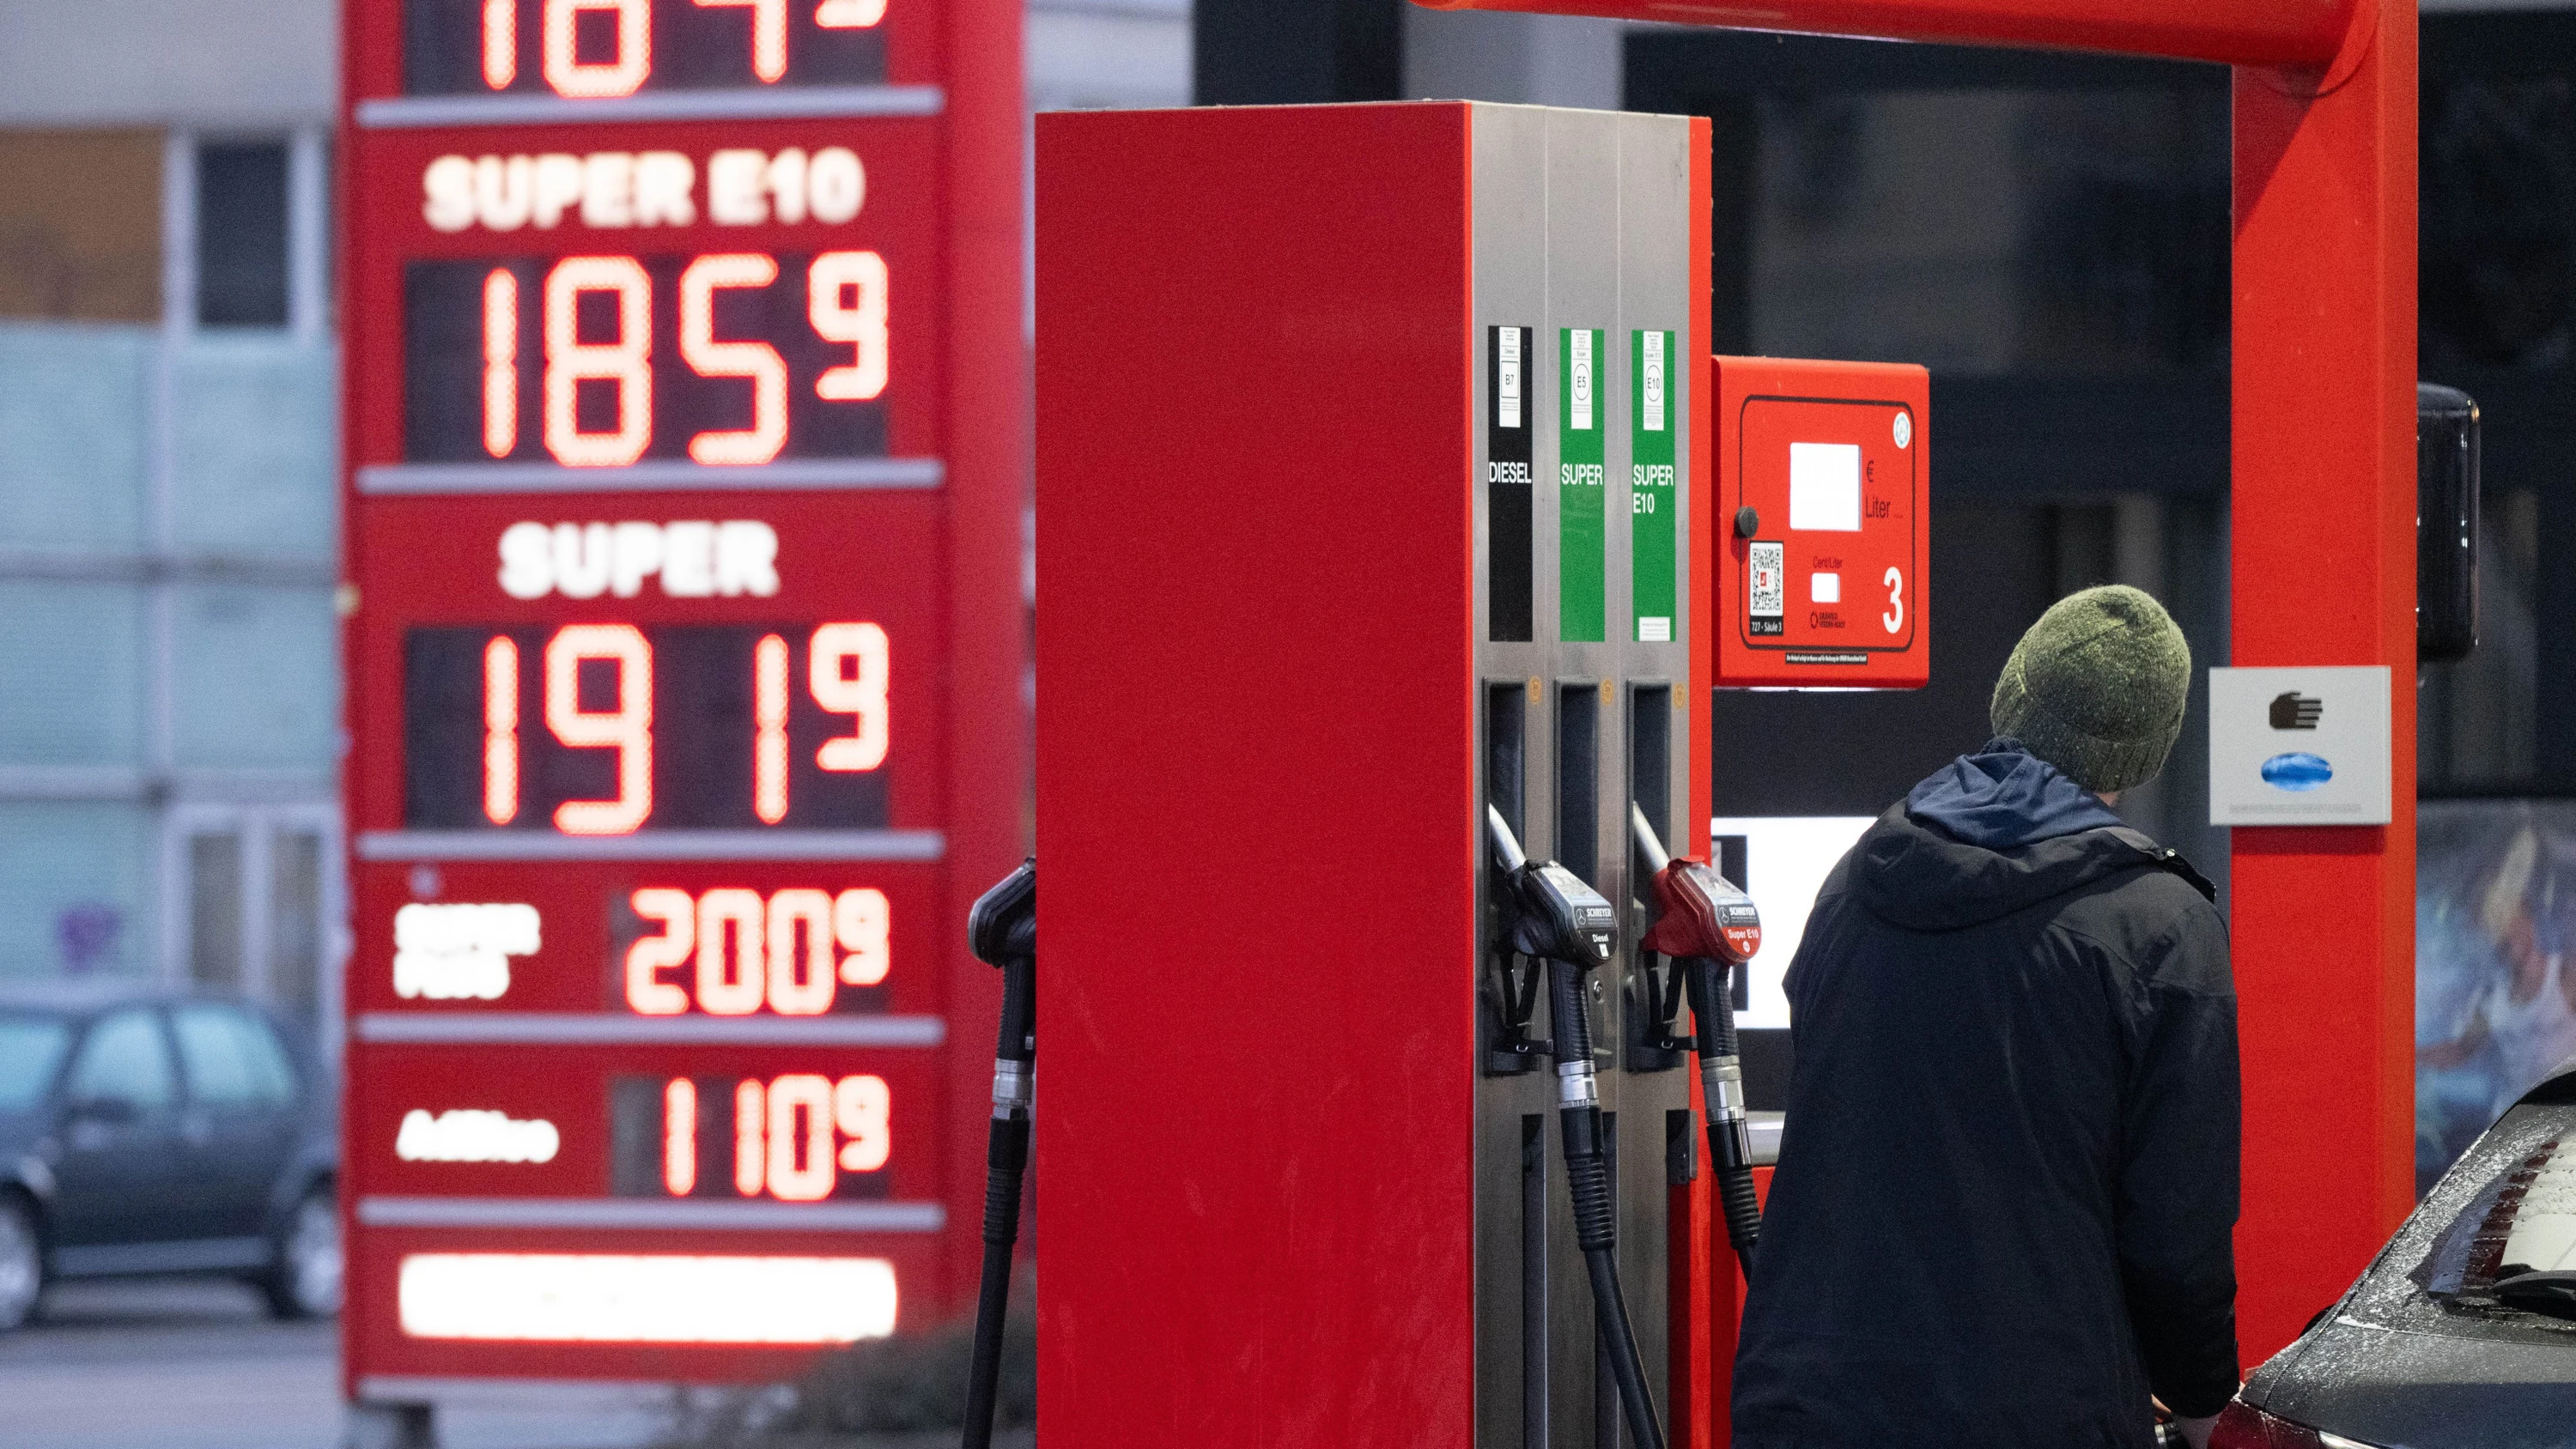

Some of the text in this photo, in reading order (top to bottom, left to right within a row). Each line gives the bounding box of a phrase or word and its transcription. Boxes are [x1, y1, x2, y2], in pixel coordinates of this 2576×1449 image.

[424, 146, 866, 232] SUPER E10
[1505, 373, 1515, 385] B7
[1577, 376, 1587, 388] E5
[1647, 377, 1661, 390] E10
[1488, 462, 1532, 484] DIESEL
[1561, 464, 1603, 485] SUPER
[1632, 464, 1674, 486] SUPER
[1866, 459, 1874, 483] €
[1632, 493, 1655, 513] E10
[1865, 495, 1891, 519] Liter
[498, 519, 779, 599] SUPER
[1882, 567, 1904, 634] 3
[1751, 621, 1761, 633] 727
[1778, 621, 1782, 632] 3
[1586, 907, 1612, 918] SCHREYER
[1592, 933, 1609, 943] Diesel
[1728, 928, 1759, 941] Super E10
